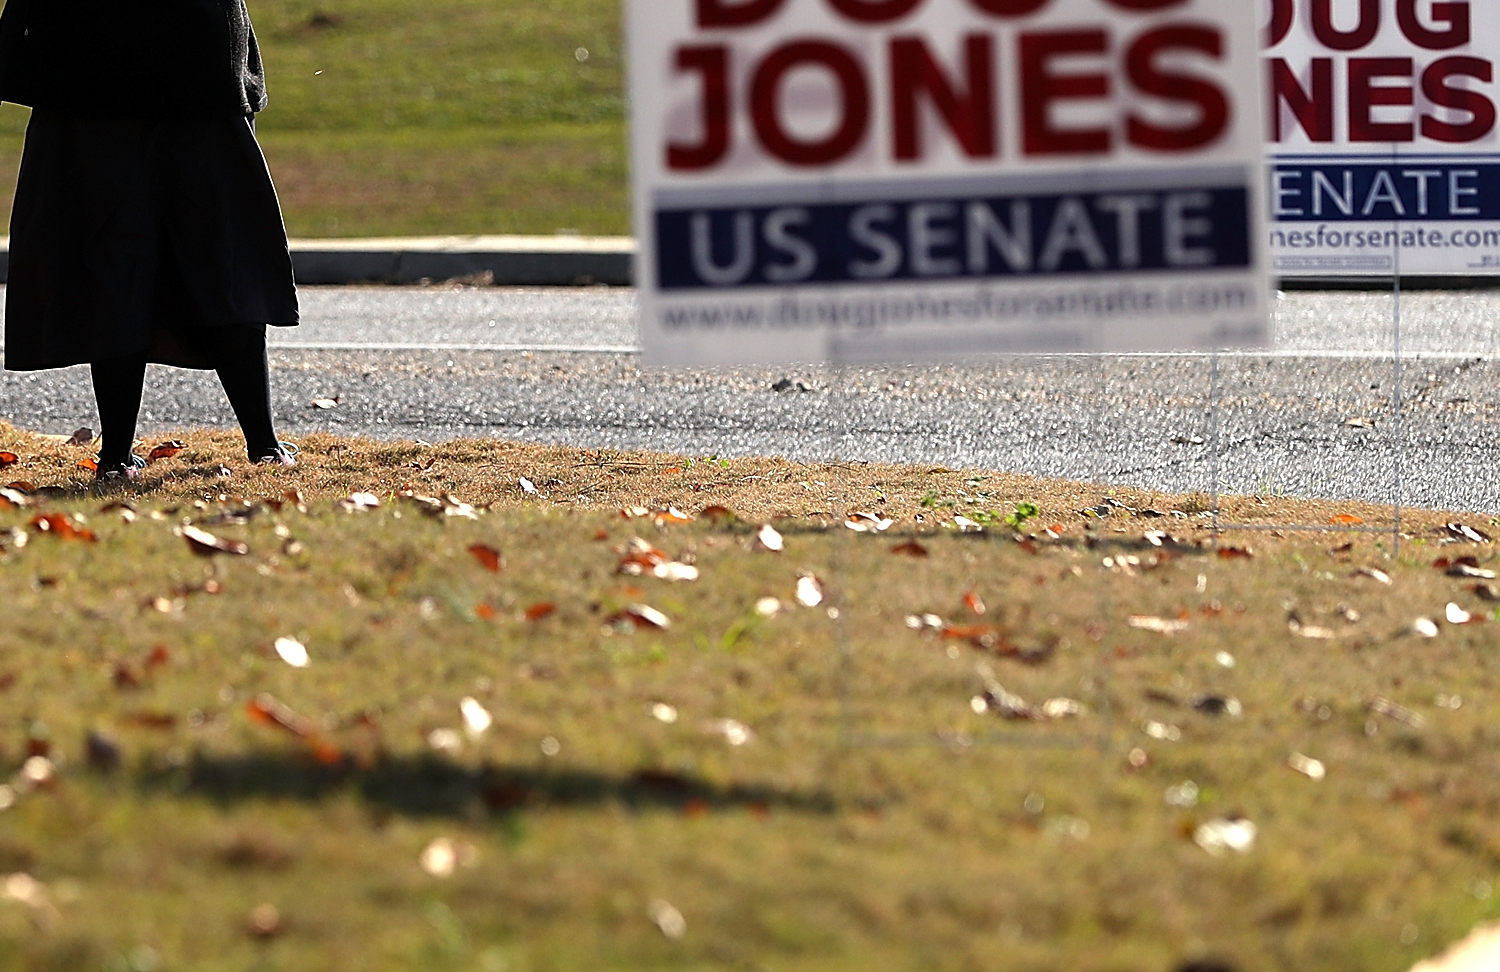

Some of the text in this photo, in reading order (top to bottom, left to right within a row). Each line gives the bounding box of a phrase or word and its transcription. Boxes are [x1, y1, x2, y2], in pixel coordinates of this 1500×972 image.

[662, 20, 1234, 174] JONES
[1266, 55, 1497, 144] NES
[1272, 169, 1480, 217] ENATE
[688, 192, 1218, 286] US SENATE
